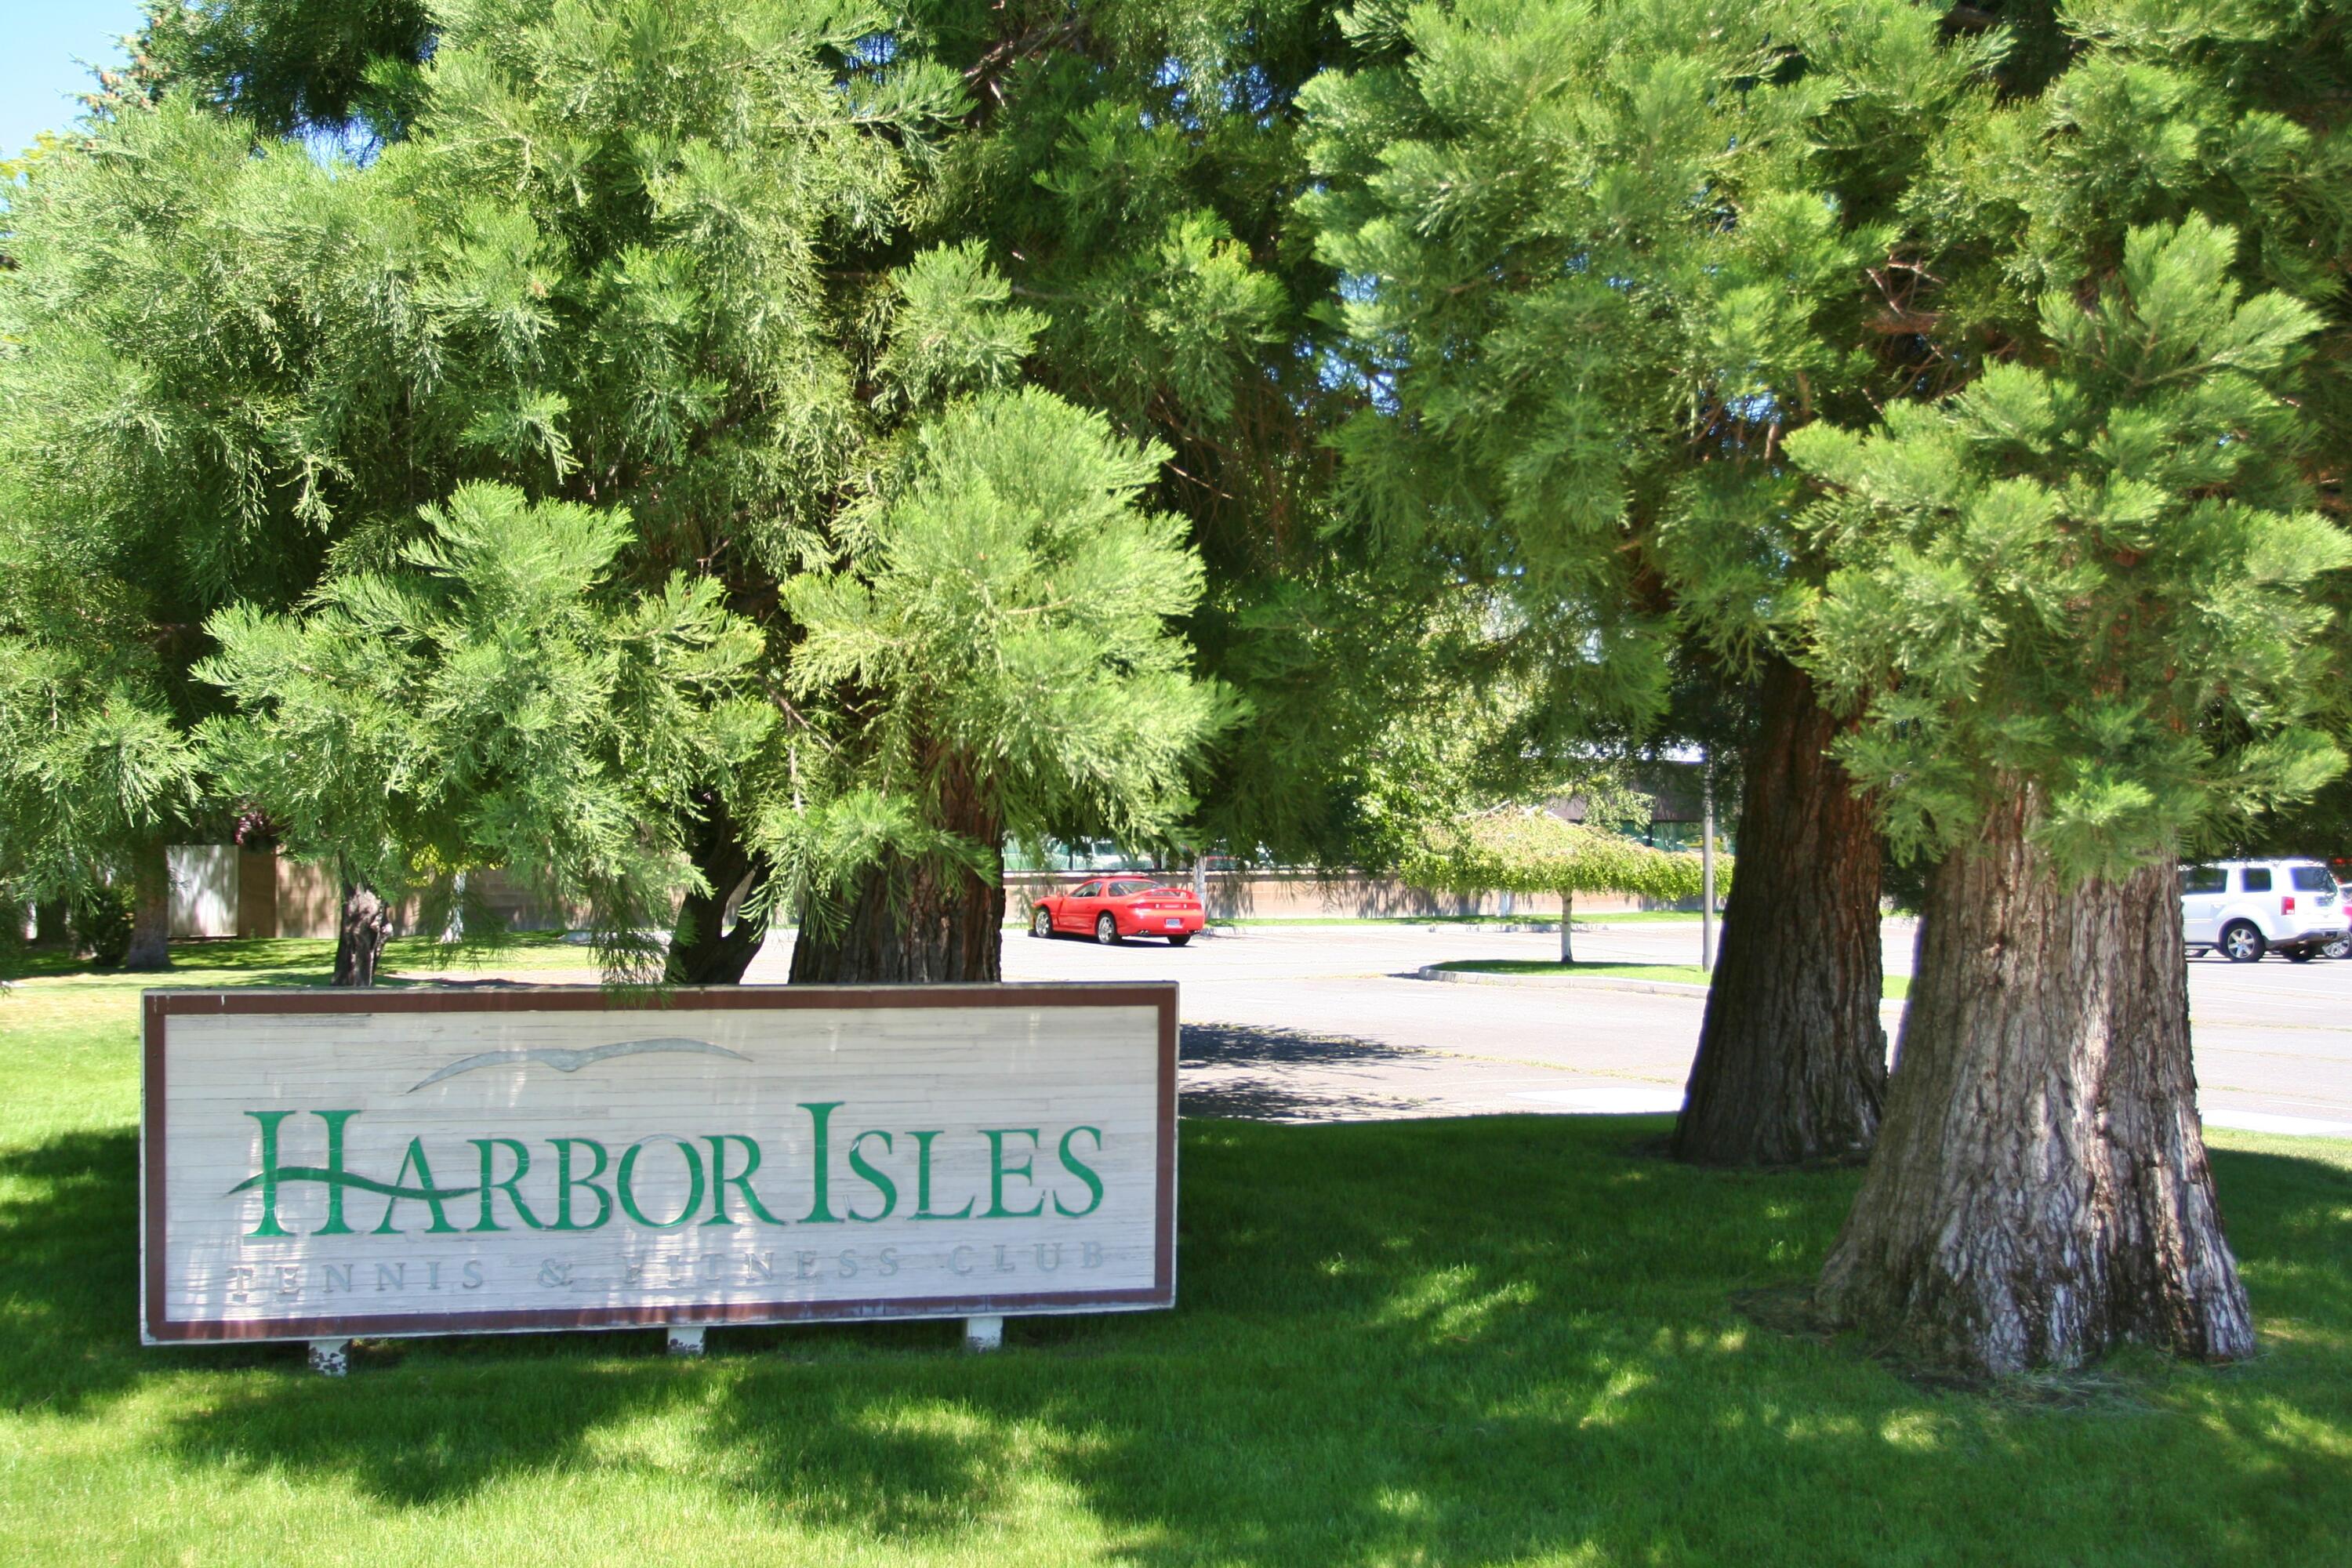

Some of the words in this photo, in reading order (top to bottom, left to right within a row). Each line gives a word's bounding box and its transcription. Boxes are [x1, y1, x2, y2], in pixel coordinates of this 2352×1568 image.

[225, 1109, 787, 1237] HARBOR
[796, 1101, 1104, 1224] ISLES
[227, 1258, 483, 1298] TENNIS
[537, 1258, 572, 1287] &
[623, 1247, 898, 1283] FITNESS
[947, 1241, 1103, 1275] CLUB
